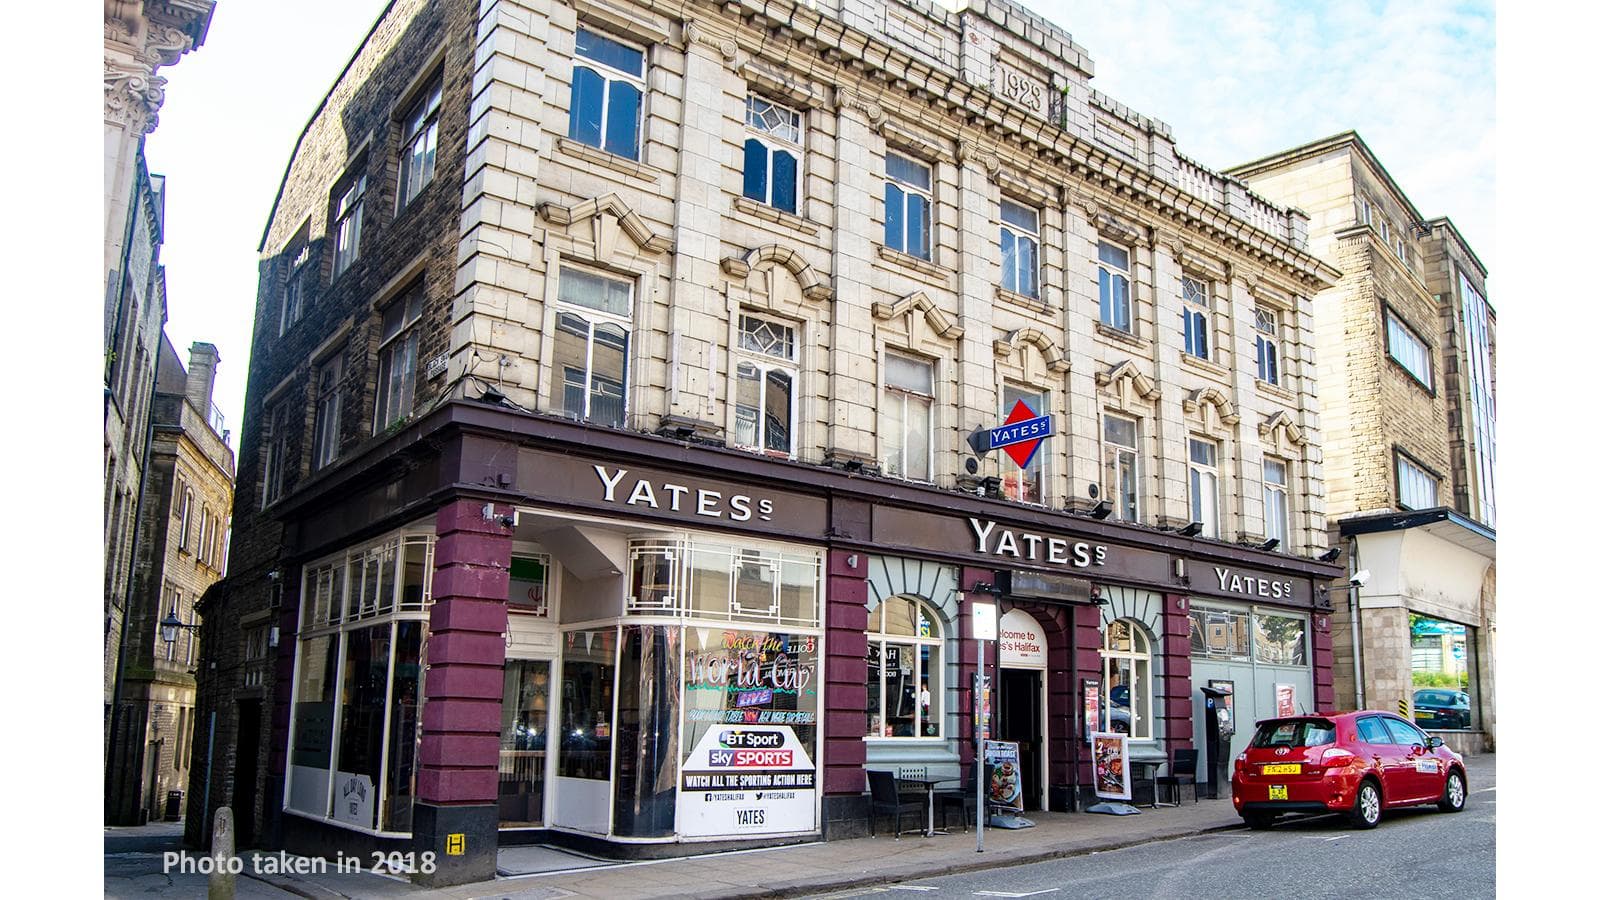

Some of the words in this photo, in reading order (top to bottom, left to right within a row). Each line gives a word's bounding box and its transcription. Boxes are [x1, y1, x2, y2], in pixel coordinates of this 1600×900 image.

[1027, 631, 1035, 641] to
[1014, 641, 1041, 653] Halifax
[686, 649, 763, 688] World
[771, 652, 811, 697] Cup
[738, 691, 769, 706] LIVE
[726, 734, 745, 745] BT
[746, 733, 778, 748] Sport
[711, 750, 733, 767] sky
[736, 750, 791, 766] SPORTS
[685, 775, 710, 788] WATCH
[711, 775, 725, 787] ALL
[726, 775, 738, 787] THE
[740, 774, 771, 787] SPORTING
[773, 774, 795, 786] ACTION
[796, 773, 813, 785] HERE
[736, 809, 765, 825] YATES
[450, 835, 462, 853] H
